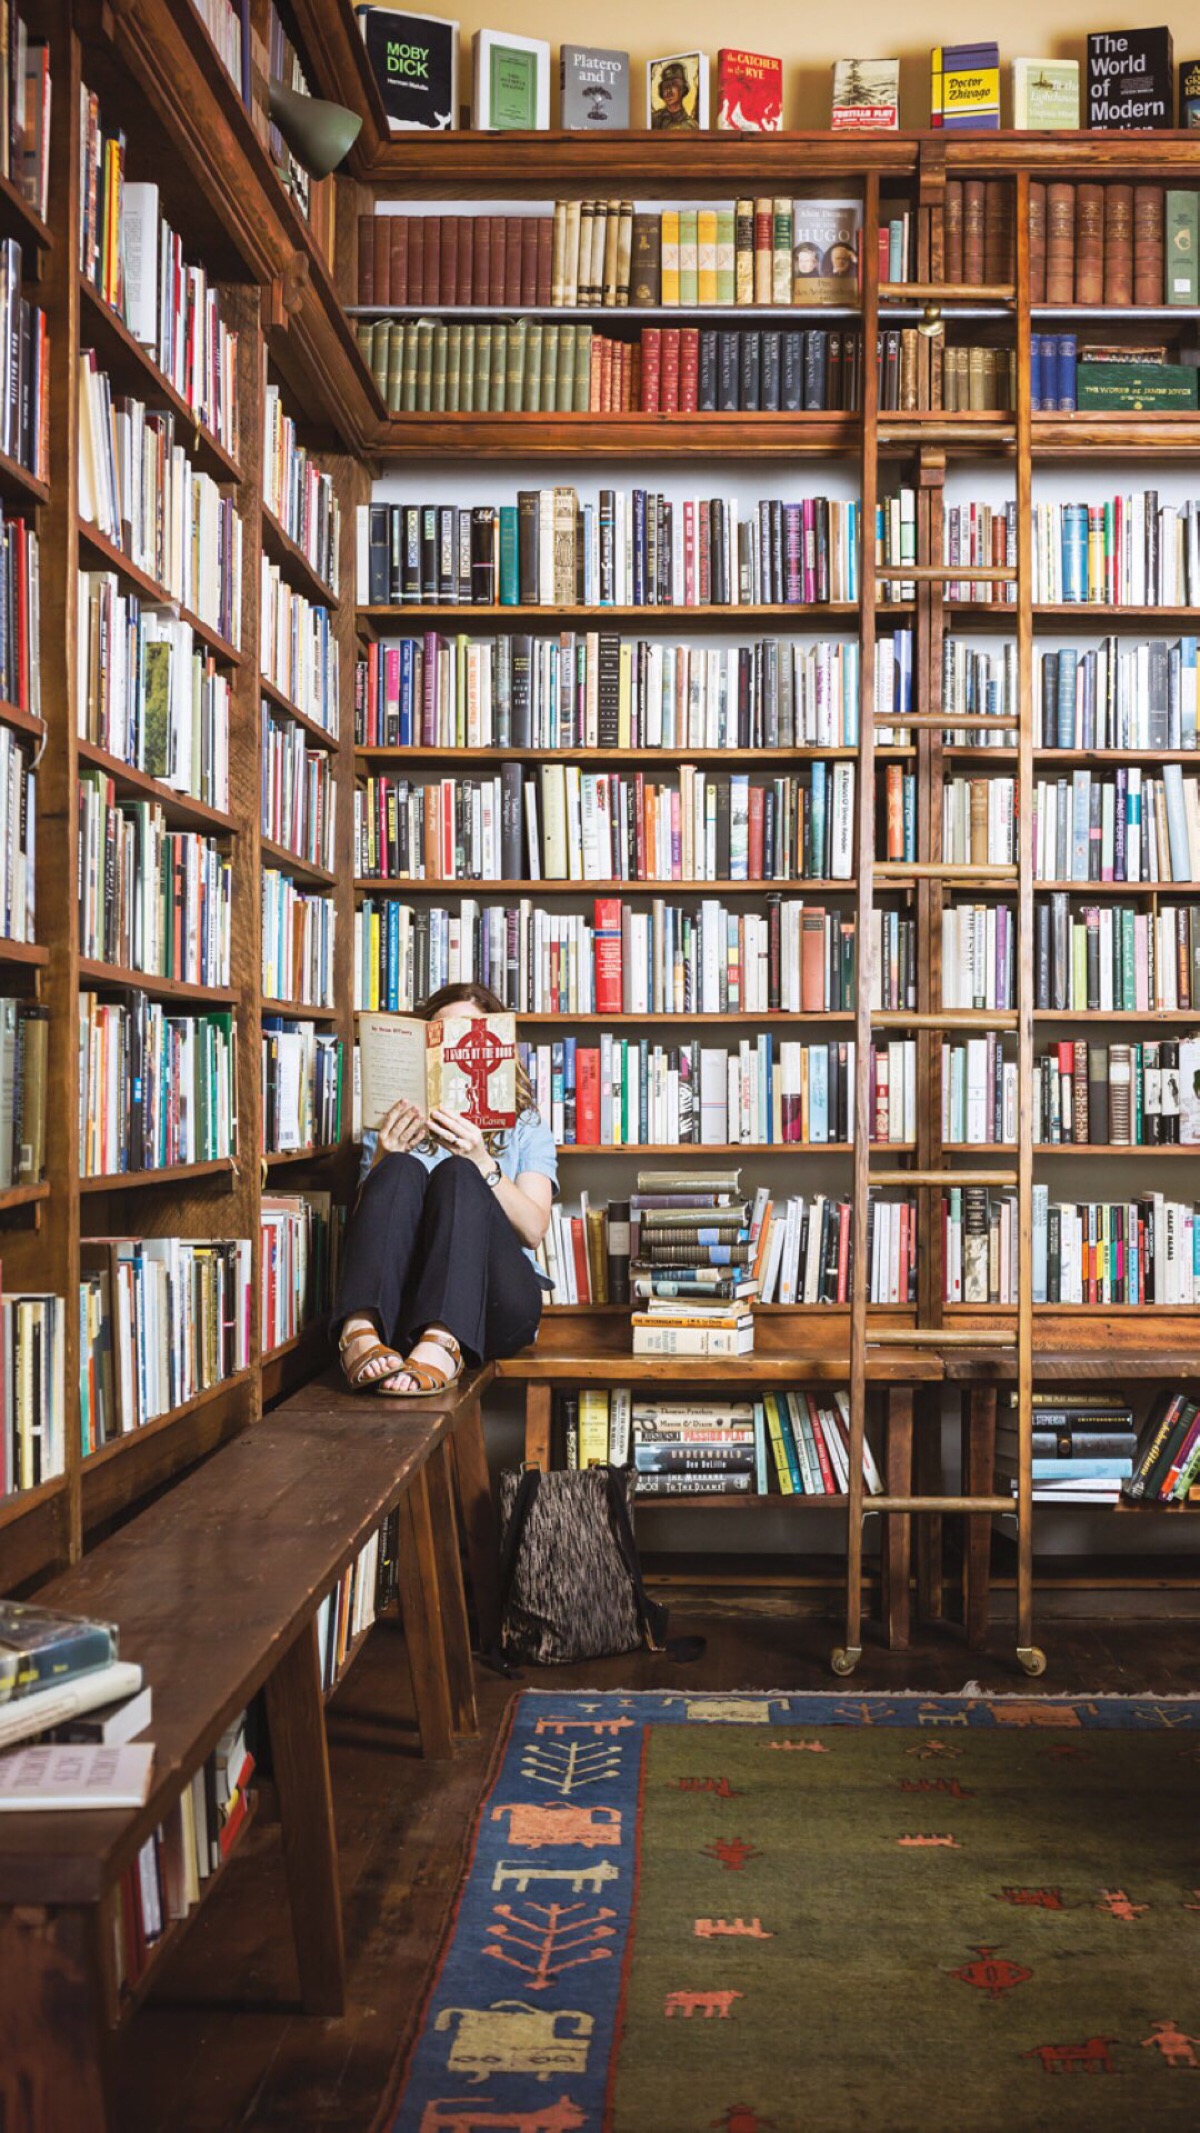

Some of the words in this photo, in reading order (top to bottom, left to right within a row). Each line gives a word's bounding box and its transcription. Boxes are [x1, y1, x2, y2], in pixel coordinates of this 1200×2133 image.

[387, 42, 429, 60] MOBY
[1091, 35, 1128, 54] The
[387, 57, 429, 78] DICK
[573, 54, 622, 72] Platero
[738, 53, 779, 70] CATCHER
[1091, 53, 1146, 76] World
[579, 70, 605, 83] and
[610, 72, 616, 85] I
[745, 68, 765, 80] RYE
[949, 78, 983, 89] Doctor
[1091, 78, 1111, 98] of
[948, 88, 991, 101] Zhivago
[1091, 100, 1164, 121] Modern
[799, 228, 850, 241] HUGO
[788, 509, 800, 532] HENRY
[788, 533, 800, 558] MILLER
[788, 574, 800, 601] PLEXUS
[842, 778, 850, 798] Flann
[1116, 798, 1124, 818] PAST
[1116, 819, 1124, 857] PERFECT
[660, 1407, 681, 1415] Thomas
[687, 1407, 713, 1415] Pynchon
[641, 1431, 681, 1442] KOSINSKI
[684, 1429, 723, 1441] PASSION
[724, 1429, 746, 1441] PLAY
[671, 1449, 742, 1459] UNDERWORLD
[686, 1460, 699, 1469] Don
[701, 1460, 727, 1469] DeLillo
